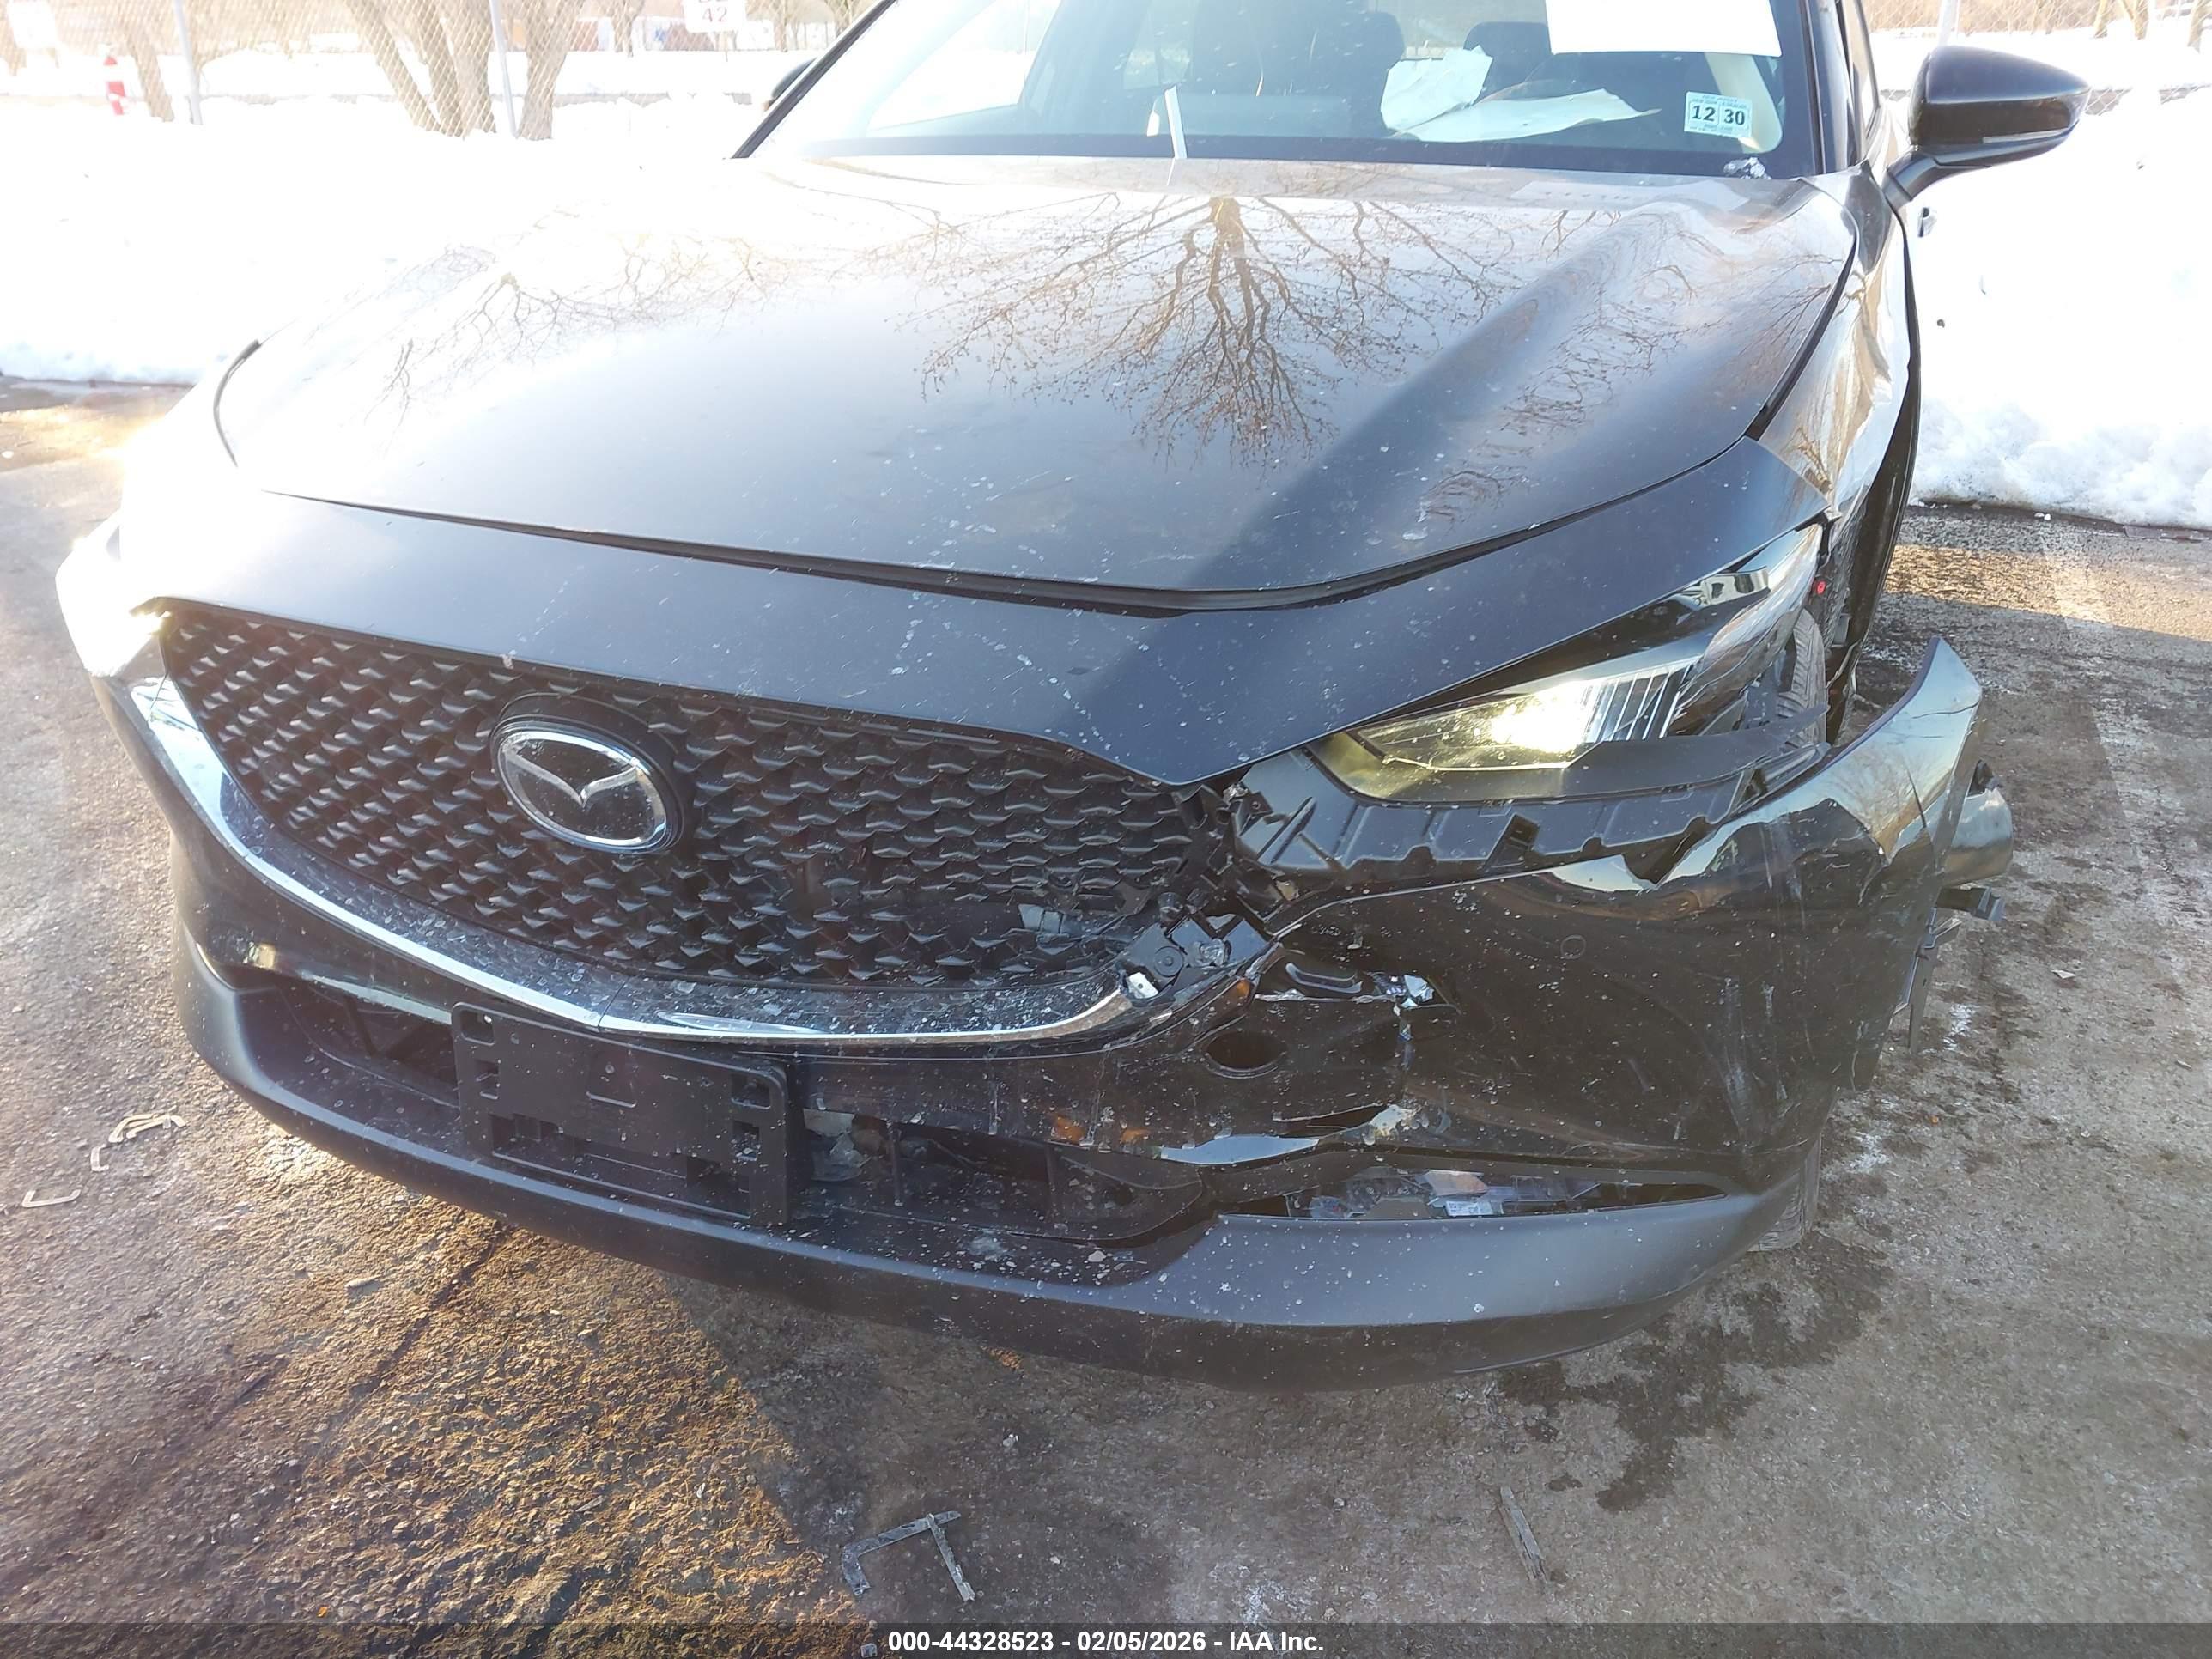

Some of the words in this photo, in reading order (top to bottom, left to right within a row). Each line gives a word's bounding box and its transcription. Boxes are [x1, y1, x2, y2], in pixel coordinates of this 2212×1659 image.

[702, 6, 728, 22] 42
[1692, 105, 1716, 122] 12
[1723, 108, 1745, 125] 30
